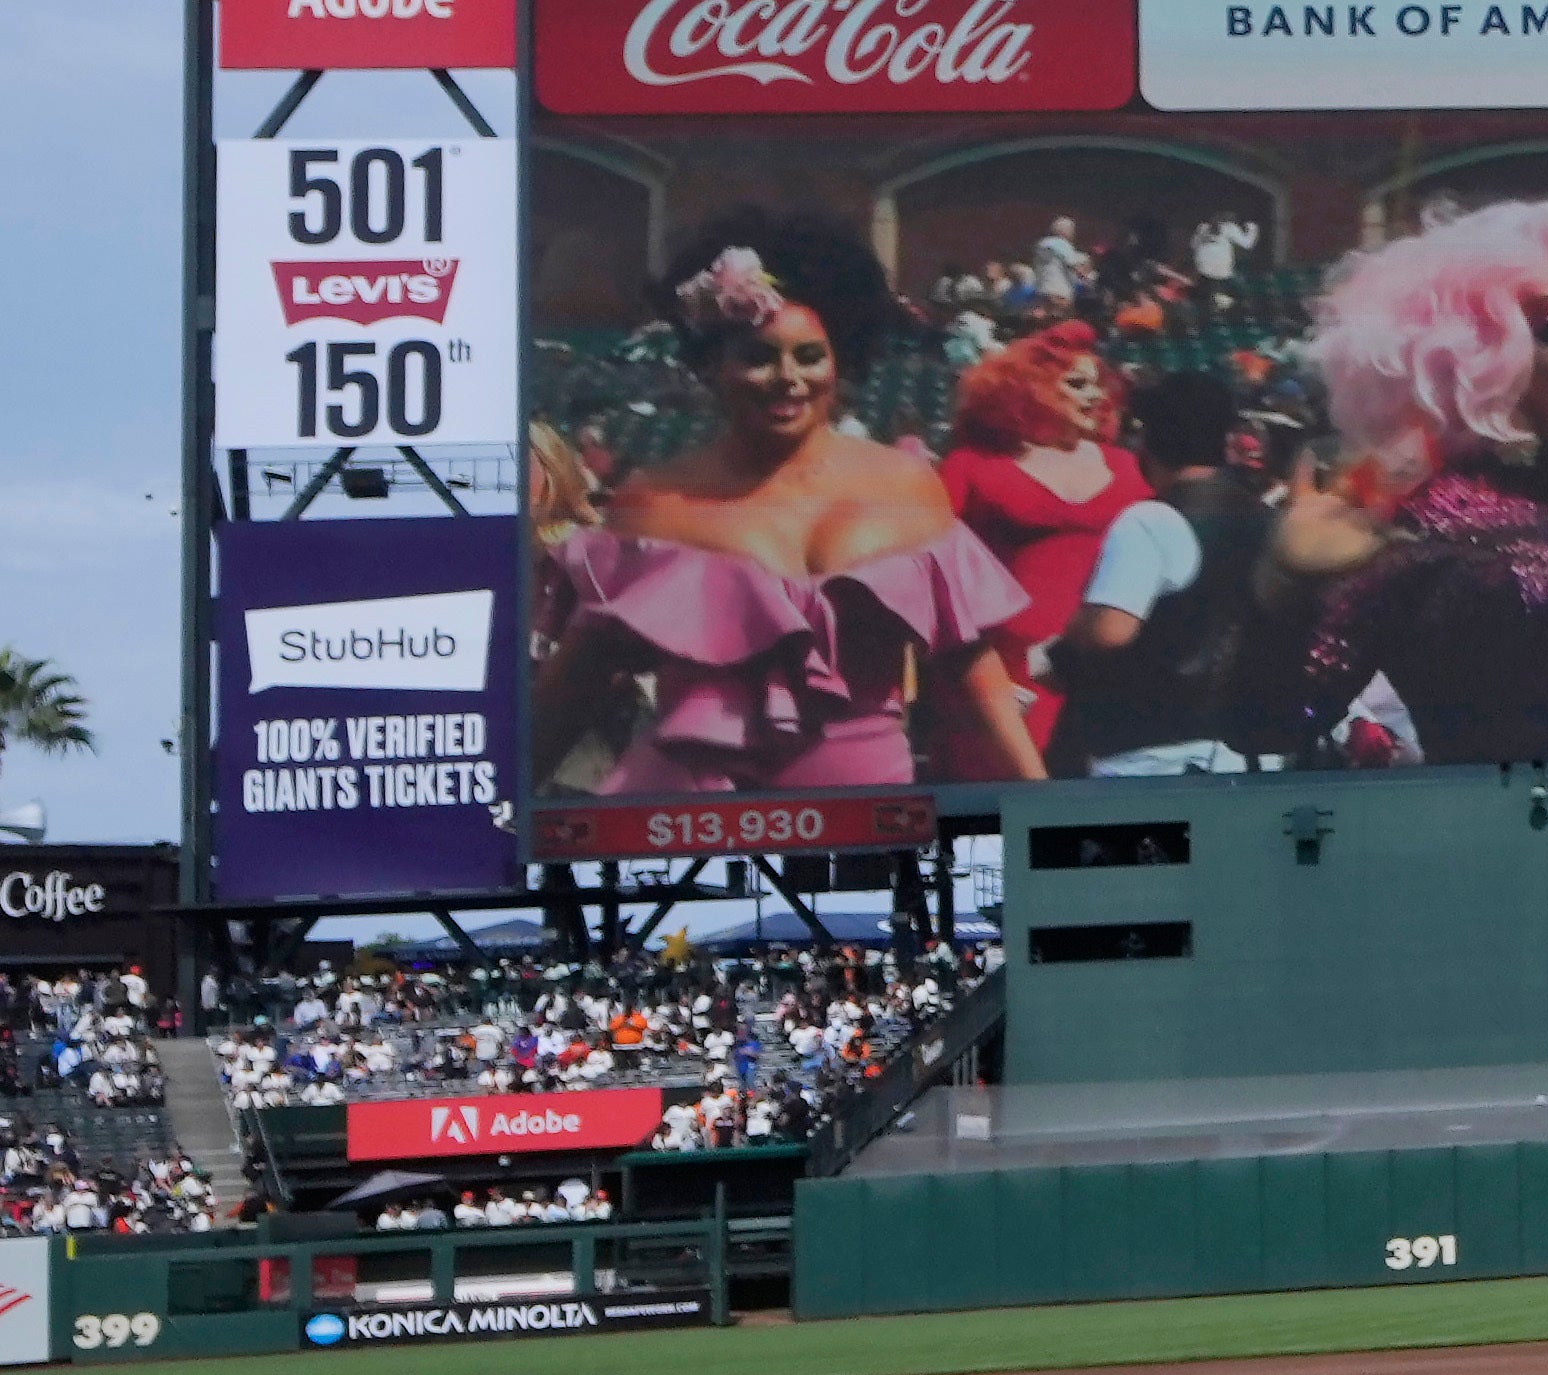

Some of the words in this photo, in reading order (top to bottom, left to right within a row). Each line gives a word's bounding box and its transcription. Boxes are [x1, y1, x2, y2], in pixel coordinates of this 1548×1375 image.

[1226, 2, 1377, 38] BANK
[1394, 2, 1463, 38] OF
[288, 146, 443, 246] 501
[279, 625, 456, 663] StubHub
[253, 718, 341, 765] 100%
[345, 713, 487, 762] VERIFIED
[242, 766, 362, 814] GIANTS
[363, 760, 498, 810] TICKETS
[646, 807, 825, 849] $13,930
[0, 869, 106, 922] Coffee
[490, 1109, 583, 1137] Adobe
[1384, 1234, 1458, 1272] 391
[73, 1311, 160, 1350] 399
[348, 1309, 466, 1341] KONICA
[467, 1301, 599, 1333] MINOLTA
